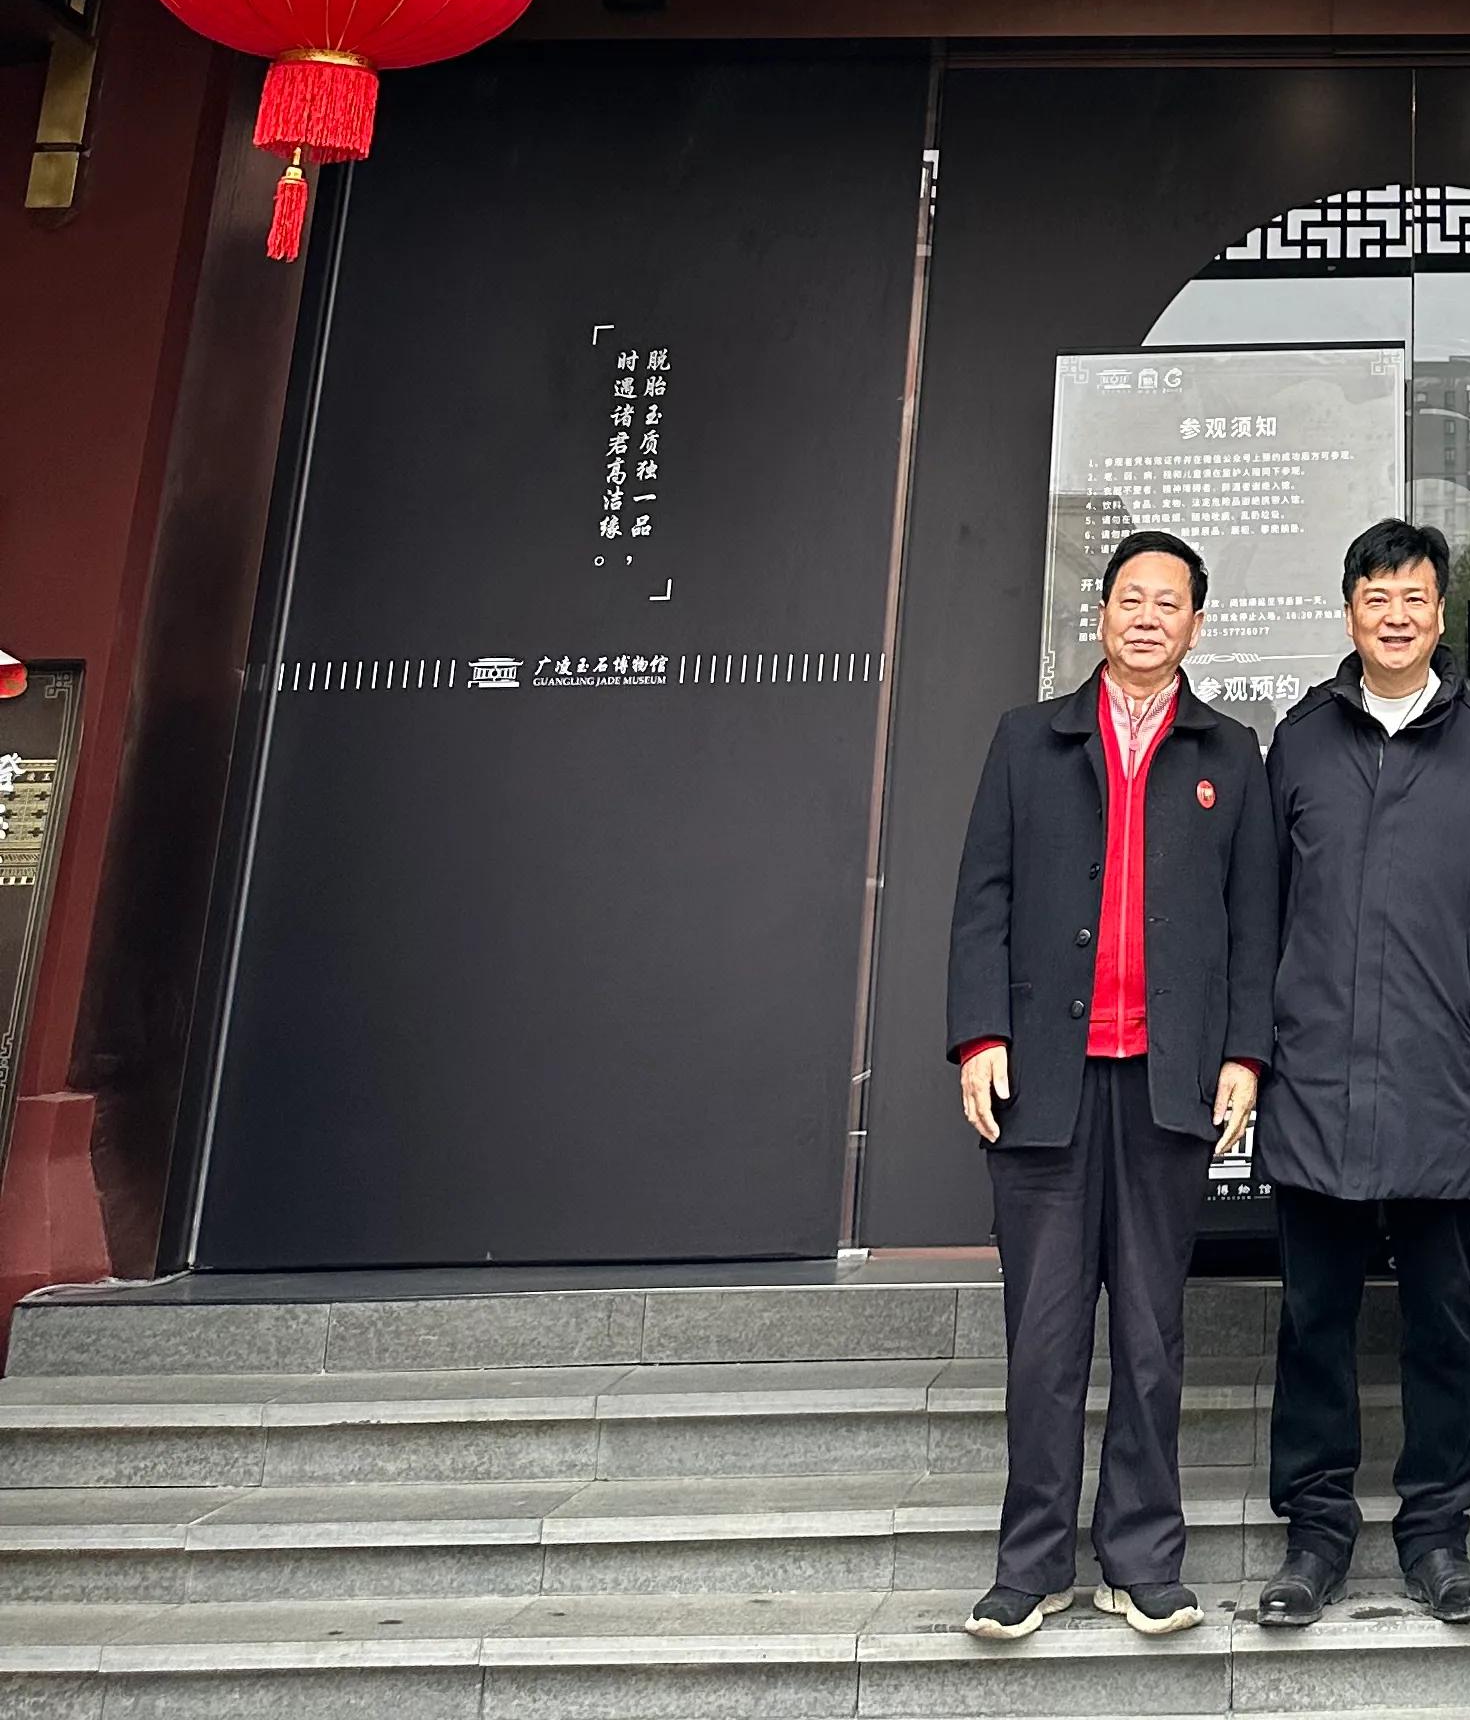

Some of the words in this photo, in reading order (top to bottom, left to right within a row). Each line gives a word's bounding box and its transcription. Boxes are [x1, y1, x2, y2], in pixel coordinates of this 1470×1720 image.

[1179, 415, 1278, 440] 参观须知
[532, 676, 595, 687] GUANGLING
[595, 676, 621, 687] JADE
[622, 675, 667, 686] MUSEUM
[1197, 674, 1300, 703] 参观预约
